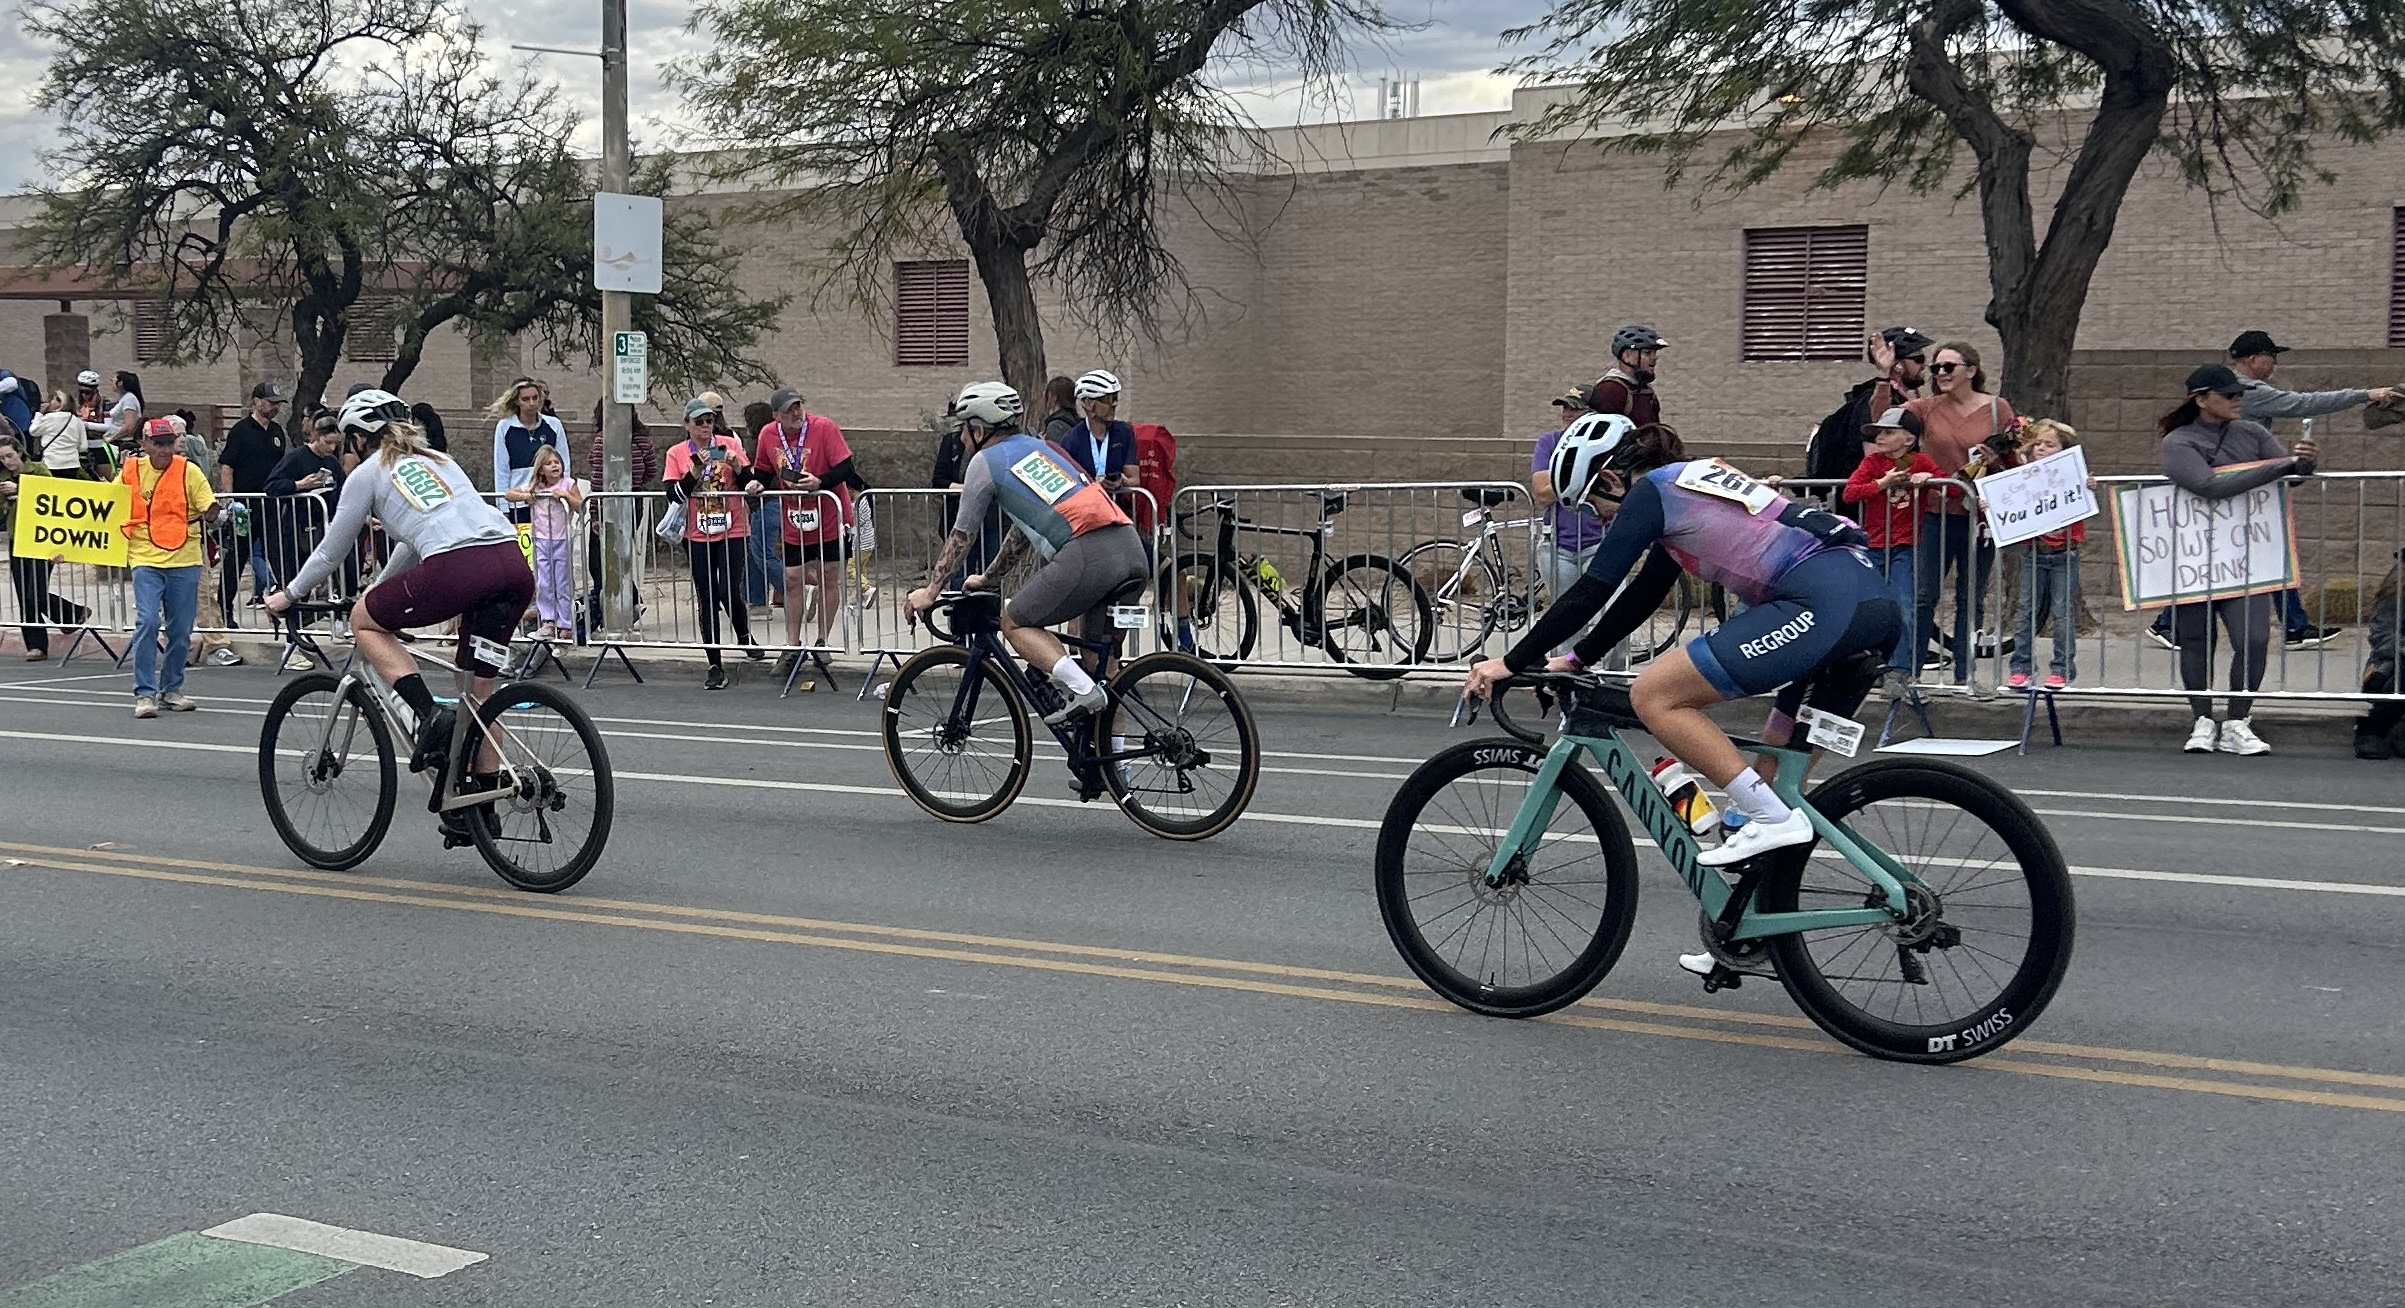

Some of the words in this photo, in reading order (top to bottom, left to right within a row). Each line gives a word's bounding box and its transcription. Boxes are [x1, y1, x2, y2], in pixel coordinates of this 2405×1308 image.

[617, 335, 627, 353] 3
[397, 461, 448, 507] 5692
[1022, 457, 1068, 494] 6319
[1700, 464, 1759, 497] 261
[35, 493, 115, 523] SLOW
[1996, 510, 2027, 526] You
[2034, 493, 2058, 516] did
[2063, 484, 2082, 505] it!
[34, 525, 109, 550] DOWN!
[2139, 536, 2169, 564] SO
[2179, 527, 2219, 557] WE
[1738, 610, 1816, 659] REGROUP
[1473, 748, 1521, 765] SWISS
[1607, 748, 1706, 900] CANYON
[1928, 1034, 1957, 1052] DT
[1961, 1007, 2013, 1046] SWISS
